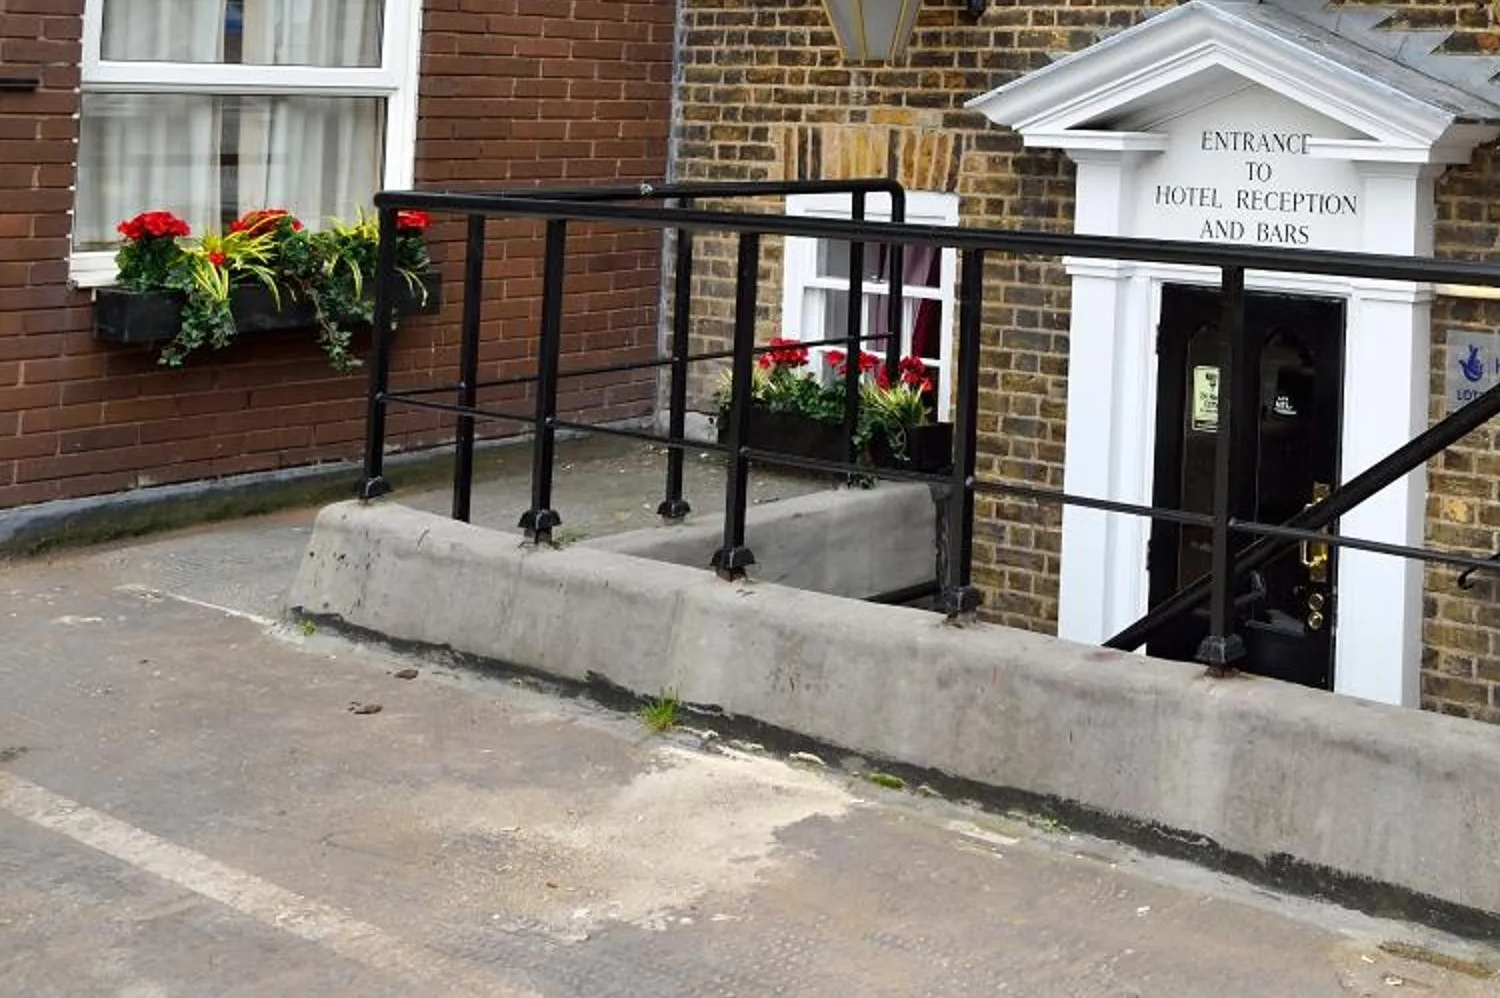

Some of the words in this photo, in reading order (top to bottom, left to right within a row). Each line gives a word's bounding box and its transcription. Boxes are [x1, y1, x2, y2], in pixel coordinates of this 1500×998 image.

[1245, 160, 1273, 182] TO
[1155, 185, 1223, 208] HOTEL
[1236, 189, 1358, 215] RECEPTION
[1200, 219, 1245, 241] AND
[1257, 222, 1310, 244] BARS
